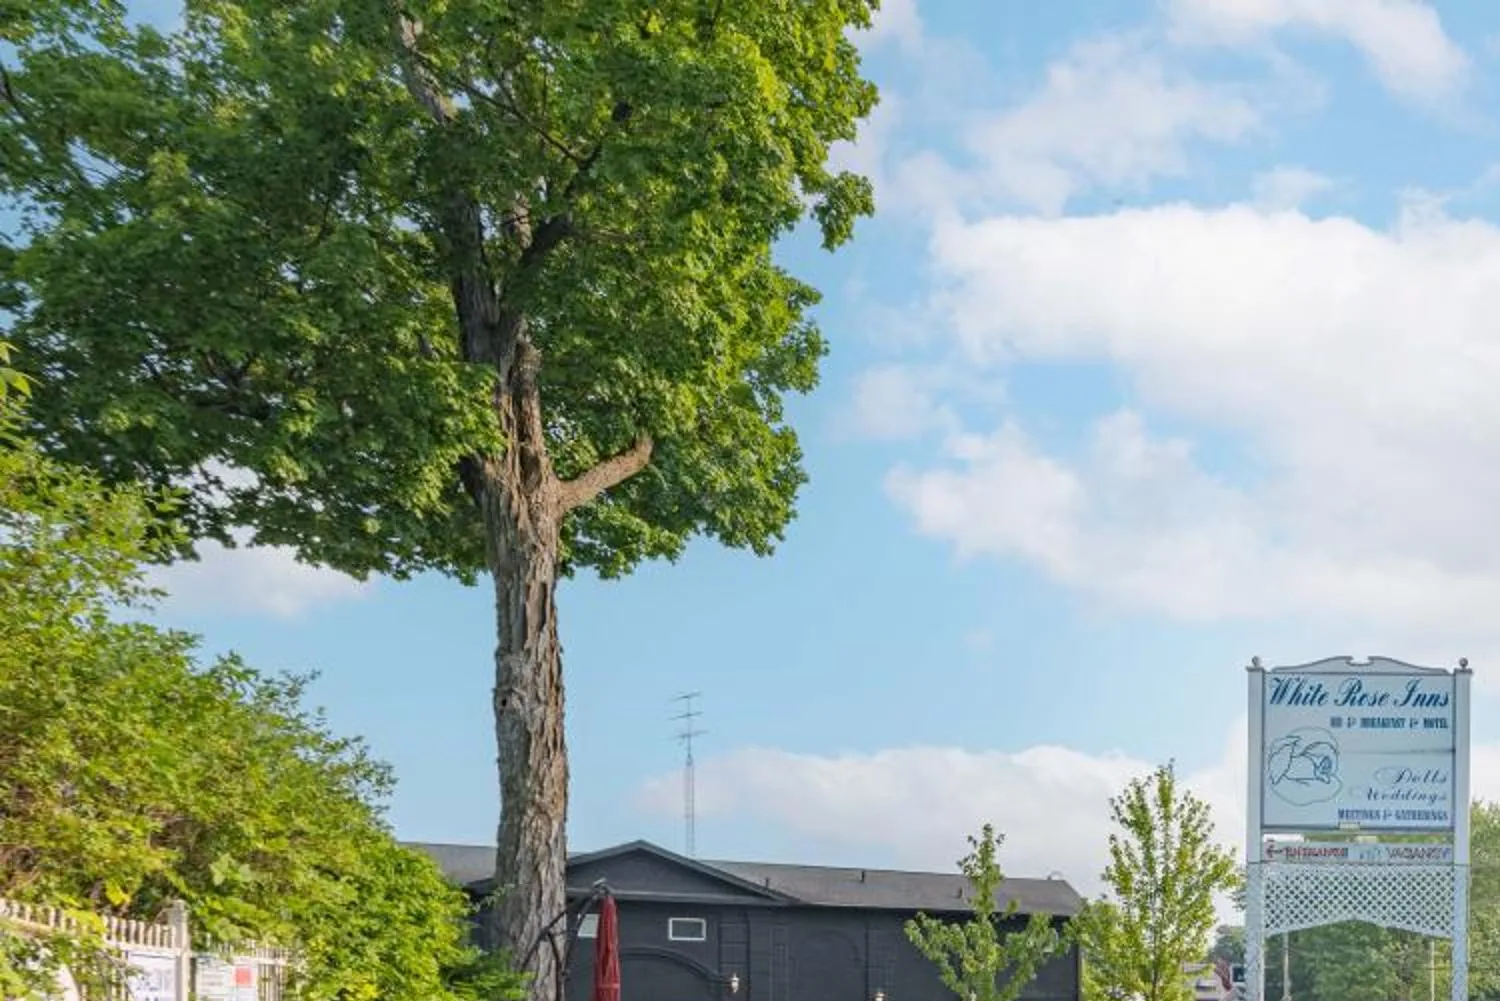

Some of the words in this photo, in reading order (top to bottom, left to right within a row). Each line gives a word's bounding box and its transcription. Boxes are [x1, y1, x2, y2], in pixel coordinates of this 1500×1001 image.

[1270, 677, 1329, 707] White
[1334, 677, 1389, 707] Rose
[1394, 678, 1448, 707] Inns
